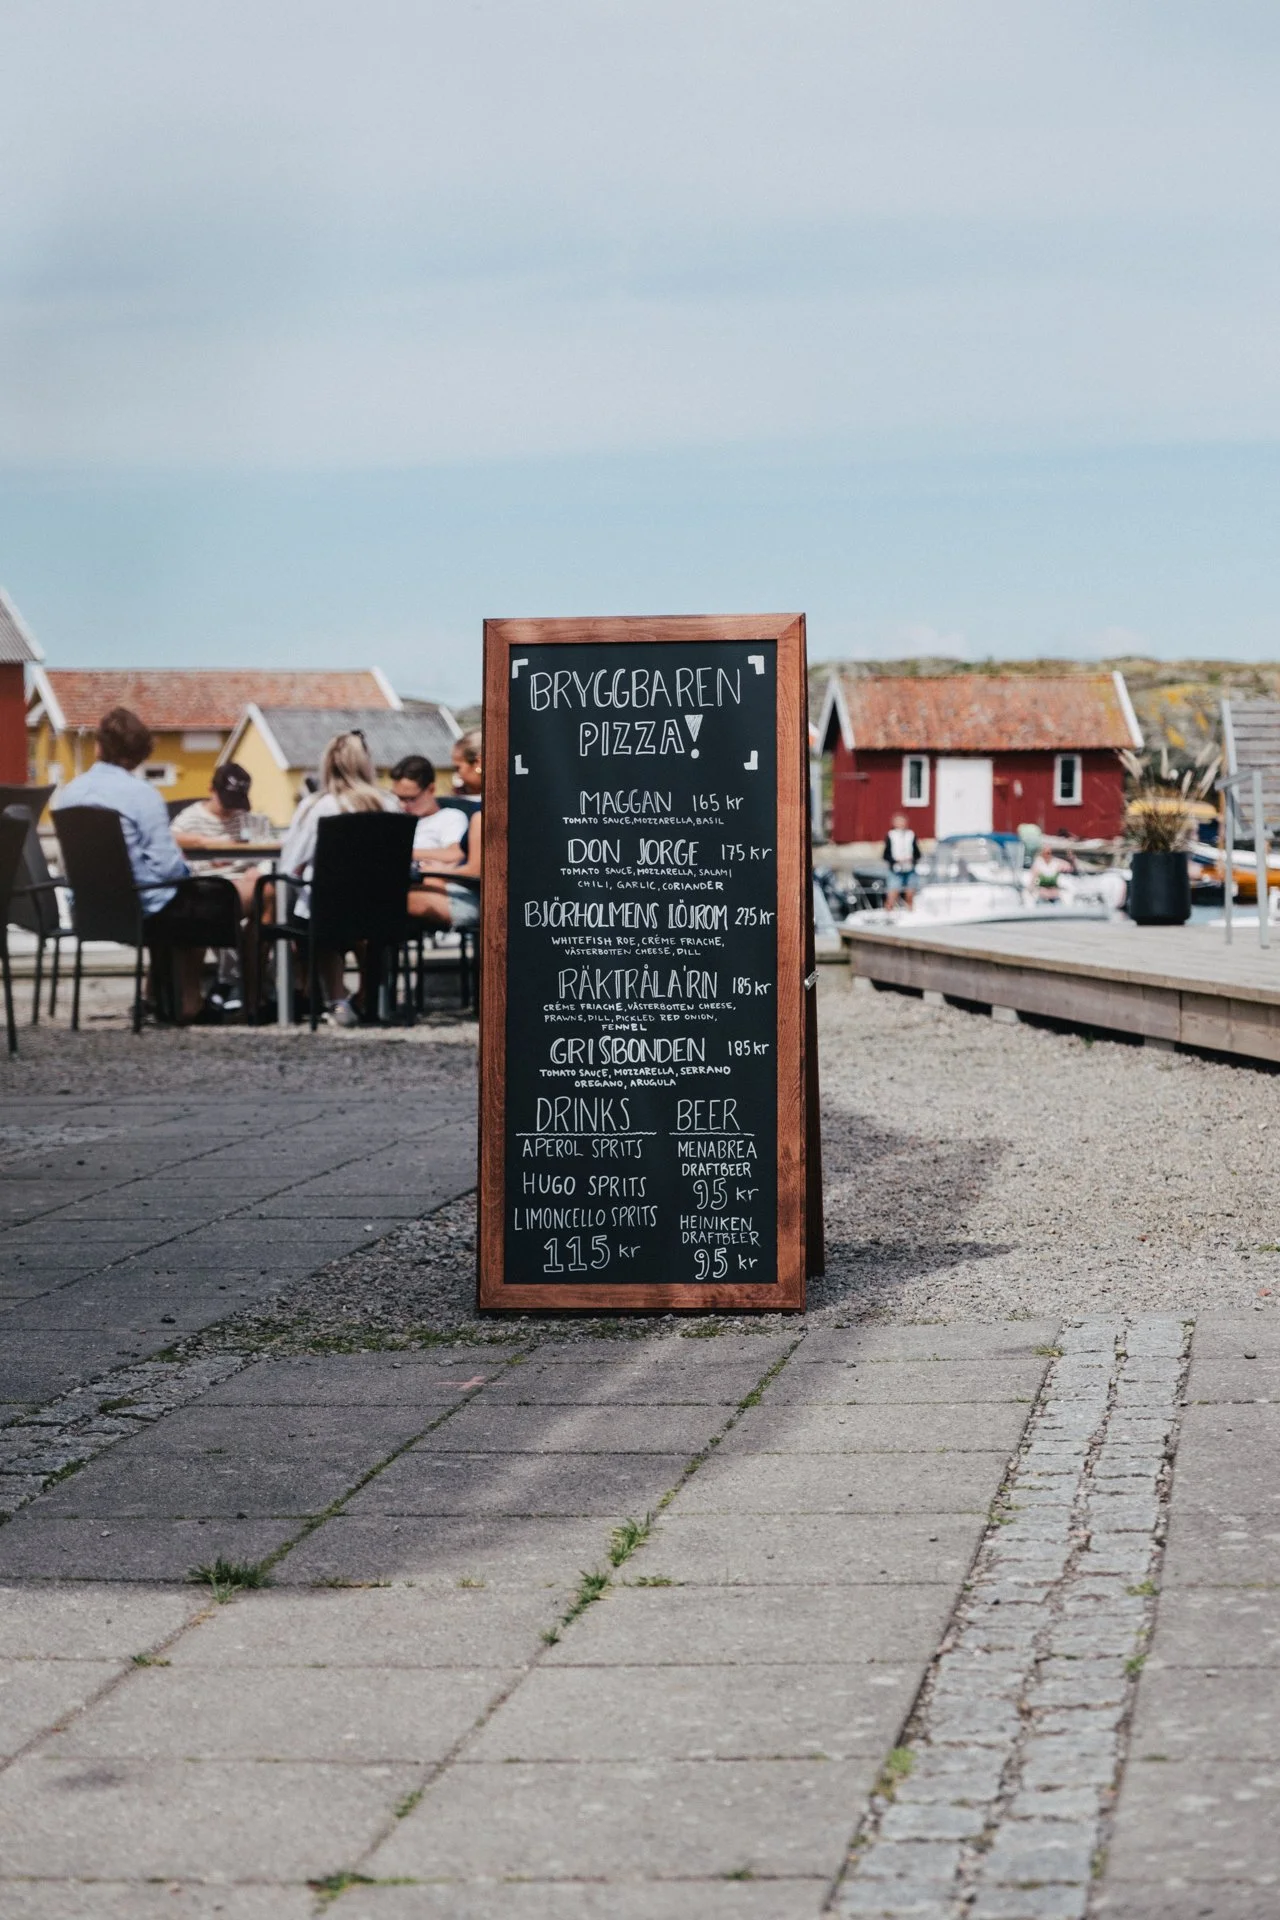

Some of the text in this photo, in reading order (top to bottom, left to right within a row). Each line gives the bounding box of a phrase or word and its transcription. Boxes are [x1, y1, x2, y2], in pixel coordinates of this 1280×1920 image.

[530, 667, 740, 711] BRYGGBAREN
[580, 714, 703, 759] PIZZA!
[580, 789, 744, 815] MAGGAN 165 kr
[568, 838, 620, 863] DON
[637, 838, 699, 866] JORGE
[722, 844, 745, 861] 175
[699, 868, 732, 878] SALAMI
[578, 880, 612, 890] CHILI,
[662, 881, 724, 890] CORIANDER
[525, 897, 775, 931] BJÖRHOLMENS LÖJROM 275 kr
[552, 936, 612, 946] WHITEFISH
[680, 937, 725, 947] FRIACHE,
[635, 947, 675, 956] CHEESE,
[677, 948, 701, 956] DILL
[732, 977, 752, 996] 185
[755, 981, 772, 996] kr
[698, 1002, 737, 1010] CHEESE,
[602, 1023, 647, 1031] FENNEL
[615, 1014, 655, 1022] PICKLED
[728, 1040, 751, 1056] 185
[753, 1041, 770, 1055] kr
[539, 1069, 576, 1077] TOMATO
[579, 1069, 611, 1078] SAUCE,
[680, 1066, 731, 1076] SERRANO
[574, 1079, 676, 1090] OREGANO, ARUGULA
[536, 1096, 630, 1132] DRINKS
[676, 1099, 740, 1131] BEER
[522, 1138, 643, 1159] APEROL SPRITS
[678, 1140, 758, 1159] MENABREA
[682, 1162, 751, 1177] DRAFTBEER
[523, 1171, 646, 1197] HUGO SPRITS
[693, 1178, 759, 1210] 95 kr
[515, 1205, 658, 1230] LIMONCELLO SPRITS
[680, 1215, 752, 1231] HEINIKEN
[682, 1231, 761, 1247] DRAFTBEER
[544, 1235, 640, 1272] 115 kr
[694, 1247, 758, 1280] 95 kr
